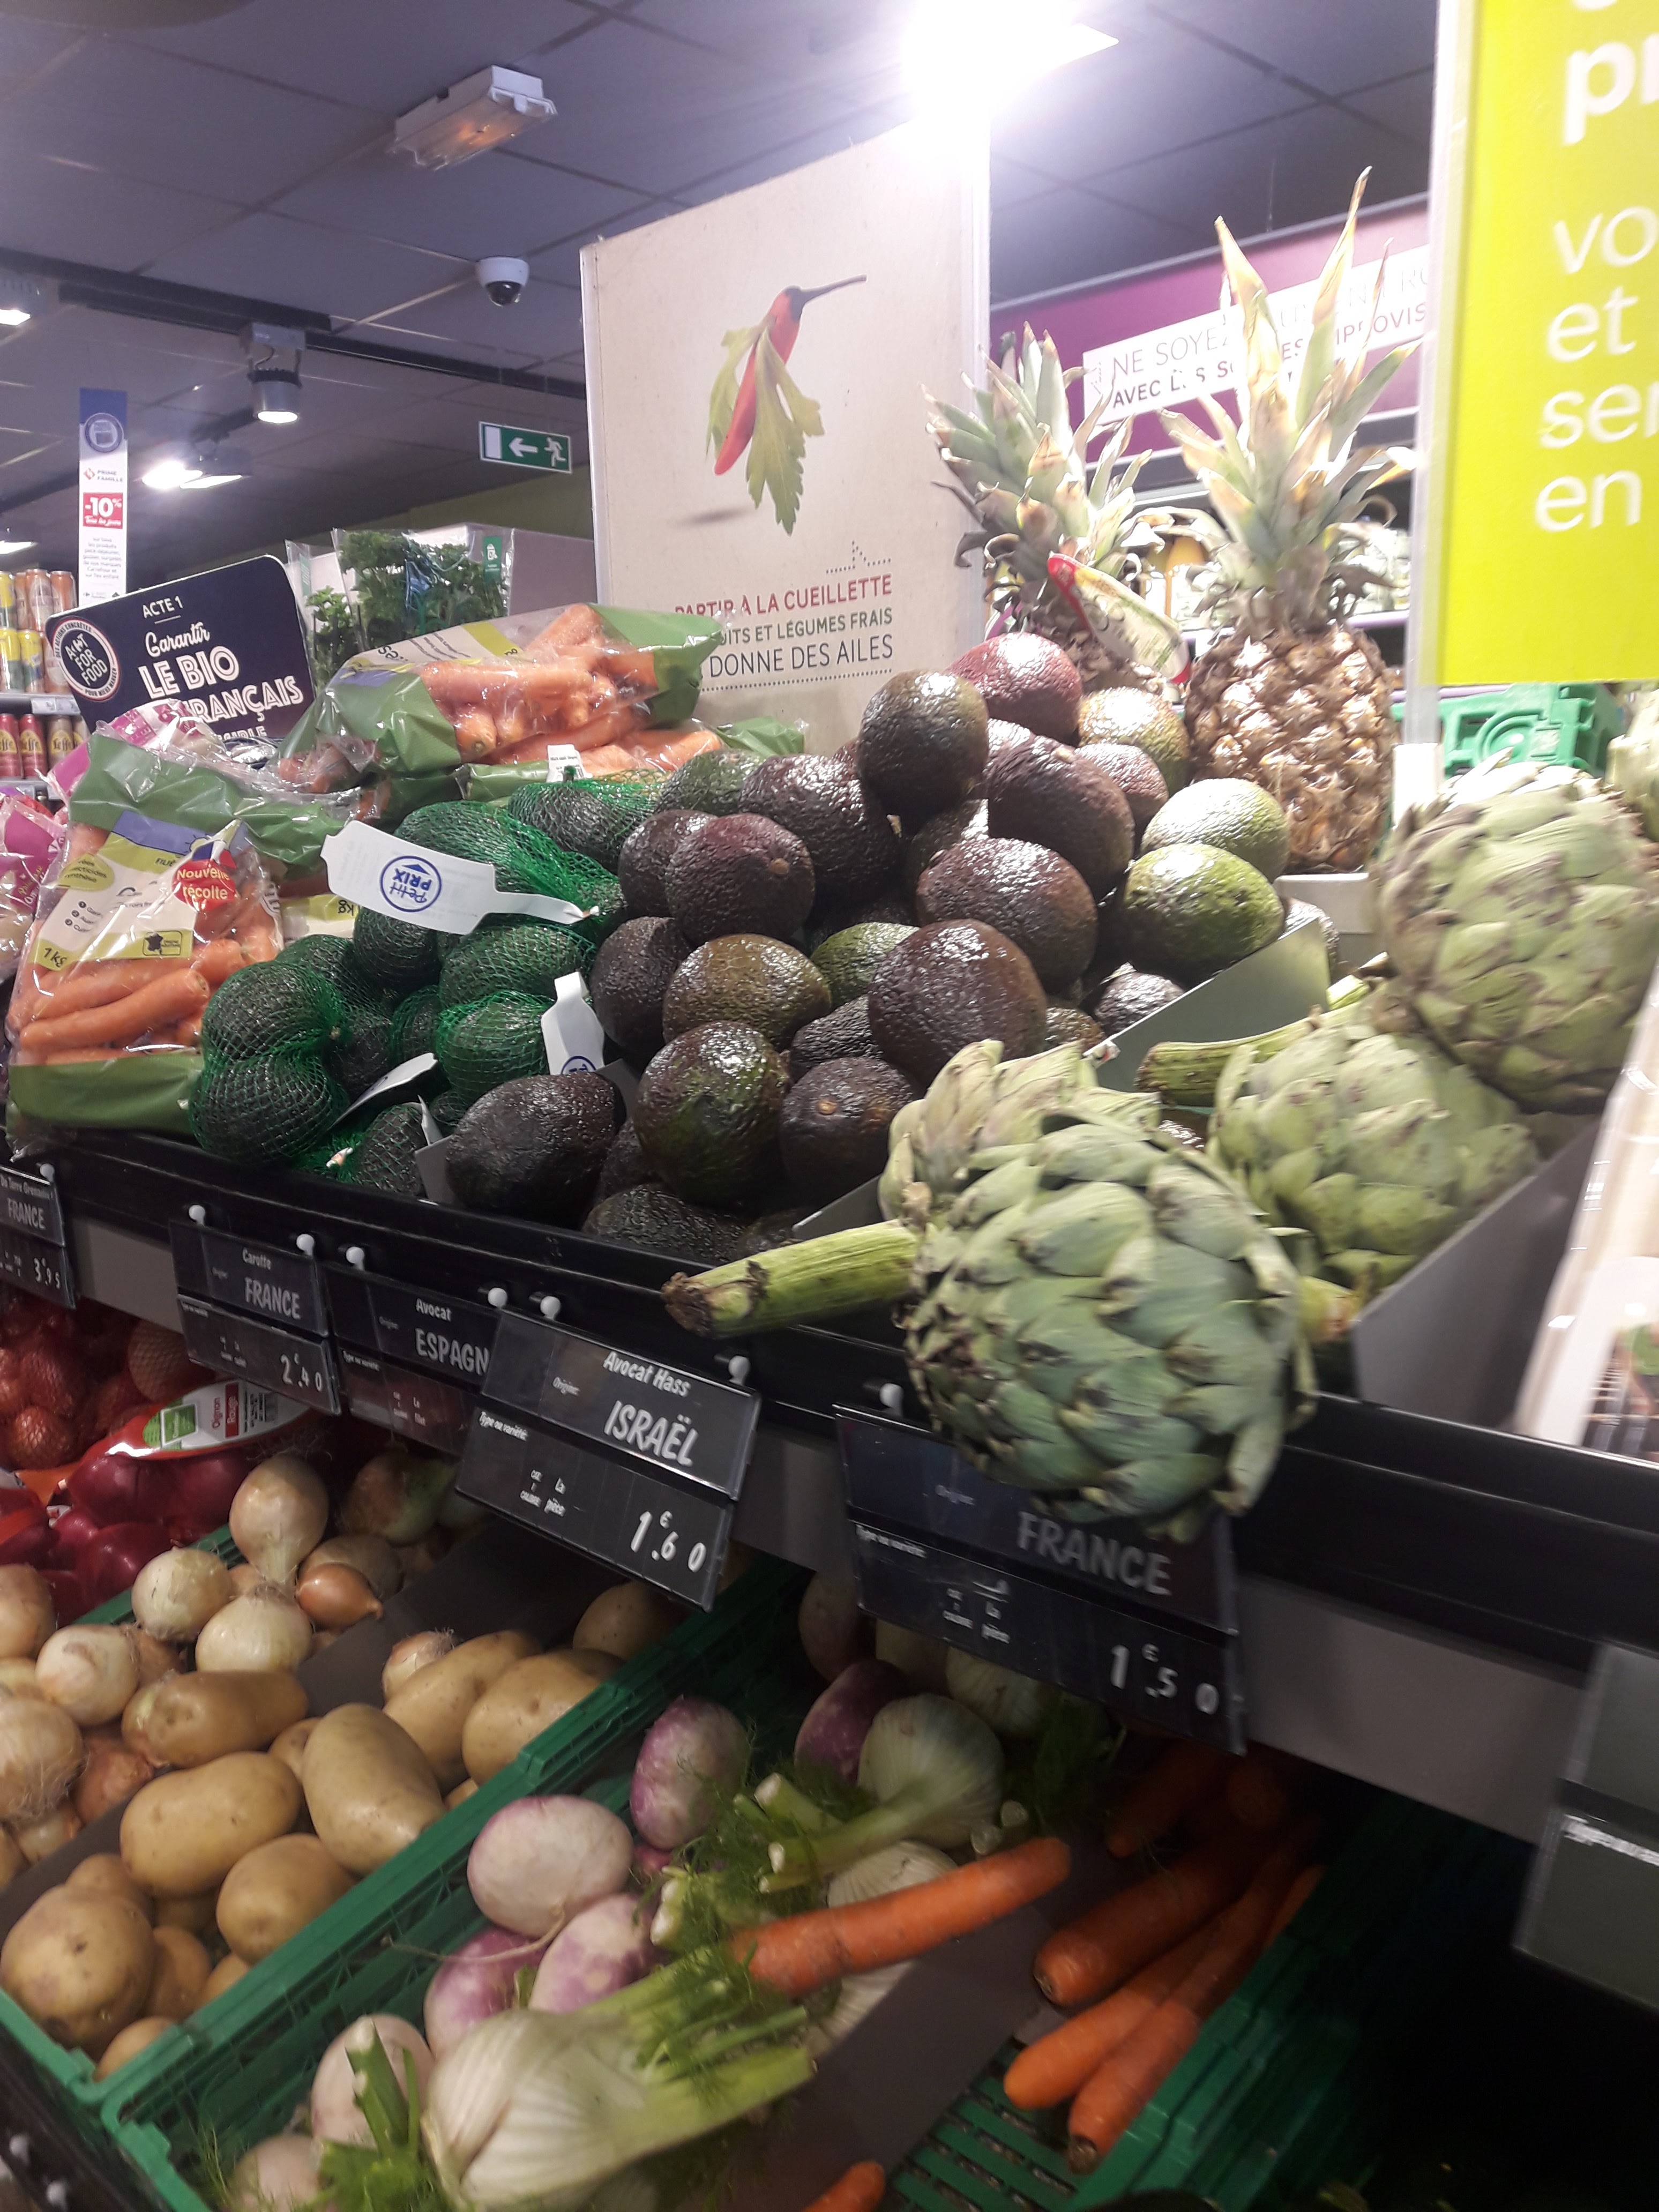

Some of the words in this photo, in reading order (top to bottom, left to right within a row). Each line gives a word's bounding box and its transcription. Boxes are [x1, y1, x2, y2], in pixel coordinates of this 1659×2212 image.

[1546, 285, 1639, 363] et
[1113, 349, 1144, 375] NE
[1113, 379, 1161, 408] AVEC
[1534, 468, 1642, 533] en
[142, 598, 175, 618] ACTE
[175, 596, 183, 609] 1
[757, 592, 779, 614] LA
[784, 573, 892, 611] CUEILLETTE
[145, 621, 210, 657] Garantir
[756, 624, 773, 642] ET
[777, 613, 846, 639] LÉGUMES
[850, 607, 892, 630] FRAIS
[74, 648, 97, 671] FOR
[710, 648, 784, 678] DONNE
[791, 642, 830, 669] DES
[836, 634, 893, 664] AILES
[81, 659, 108, 686] FOOD
[138, 660, 181, 699] LE
[176, 646, 239, 690] BIO
[182, 675, 304, 722] RANÇAIS
[176, 867, 229, 881] Nouvelle
[392, 868, 432, 891] PRIX
[183, 883, 228, 900] récolte
[389, 881, 428, 903] Petit
[7, 1197, 46, 1230] FRANCE
[242, 1247, 272, 1271] Carotte
[244, 1276, 301, 1320] FRANCE
[416, 1298, 452, 1322] Avocat
[603, 1351, 654, 1384] Avocat
[652, 1367, 691, 1397] Hass
[212, 1397, 223, 1429] Oignon
[227, 1395, 239, 1424] Rouge
[603, 1400, 699, 1467] ISRAËL
[1016, 1511, 1174, 1597] FRANCE
